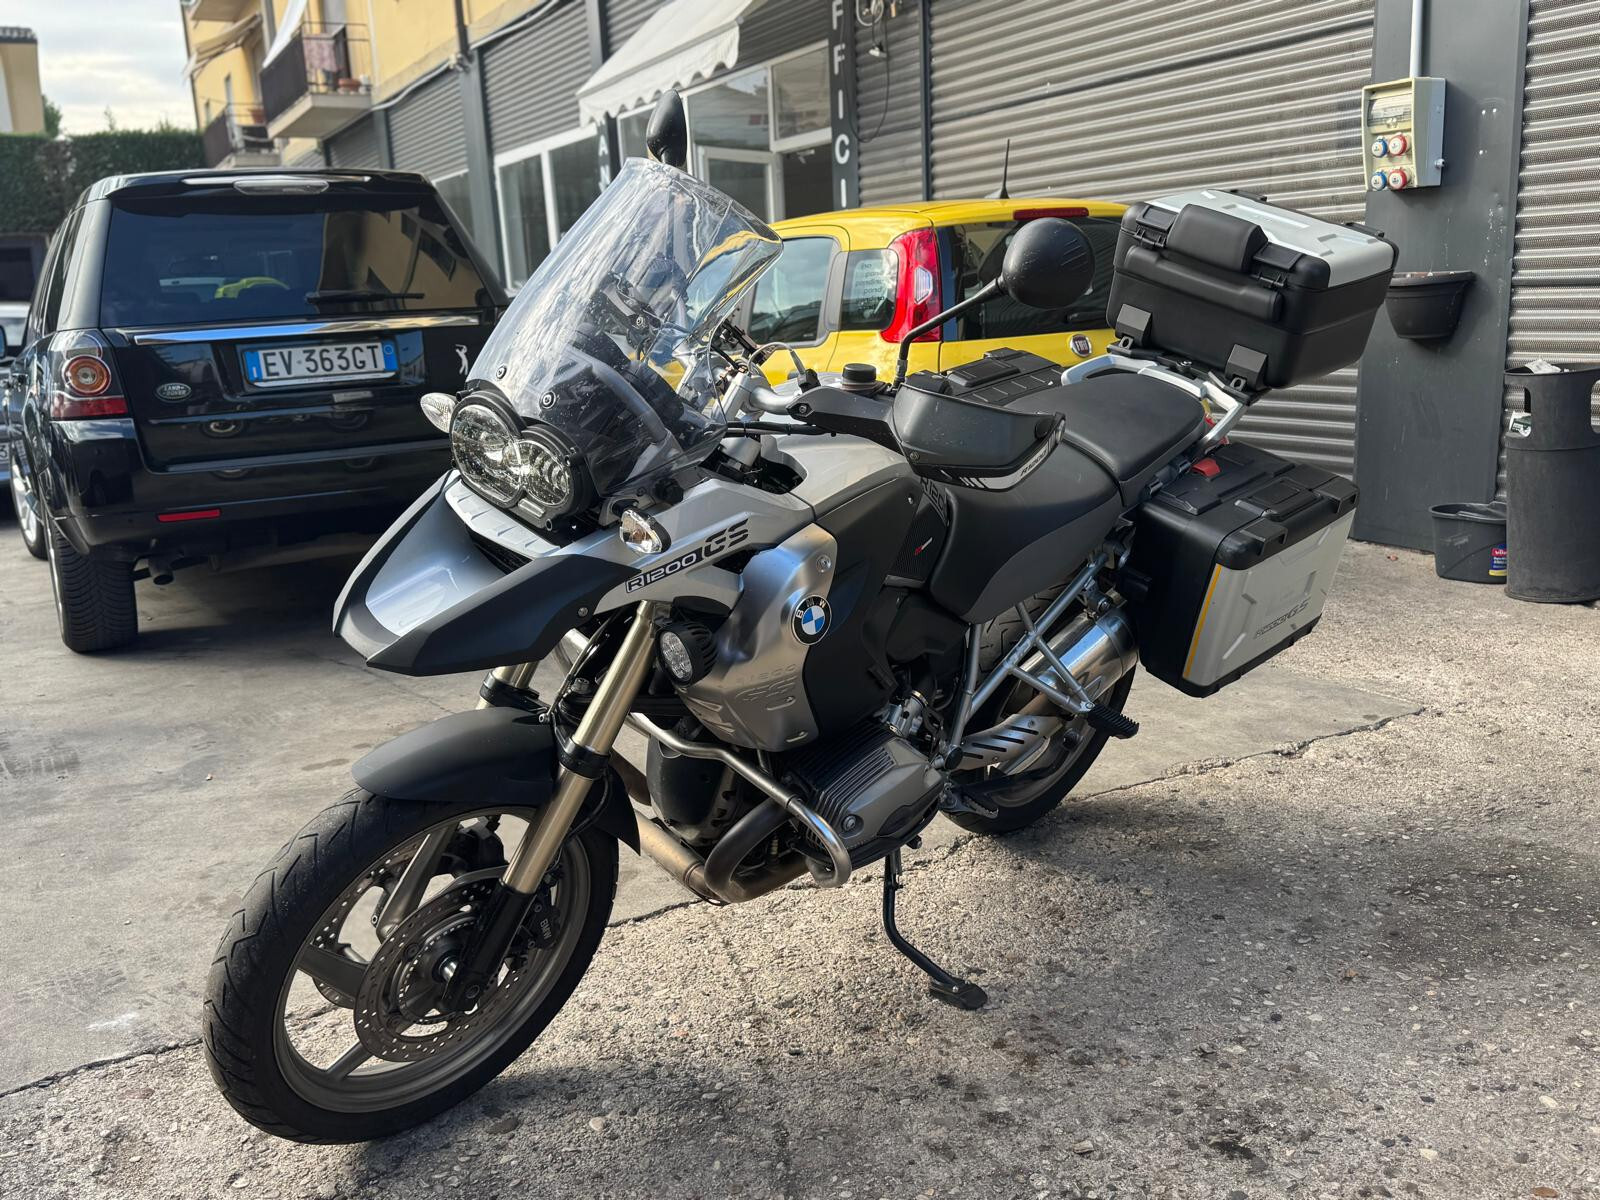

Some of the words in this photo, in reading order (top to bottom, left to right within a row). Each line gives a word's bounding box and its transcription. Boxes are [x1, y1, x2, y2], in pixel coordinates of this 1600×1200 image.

[262, 350, 293, 377] EV
[303, 345, 379, 373] 363GT
[703, 518, 749, 557] GS
[795, 597, 827, 619] BMW
[540, 918, 552, 940] BMW
